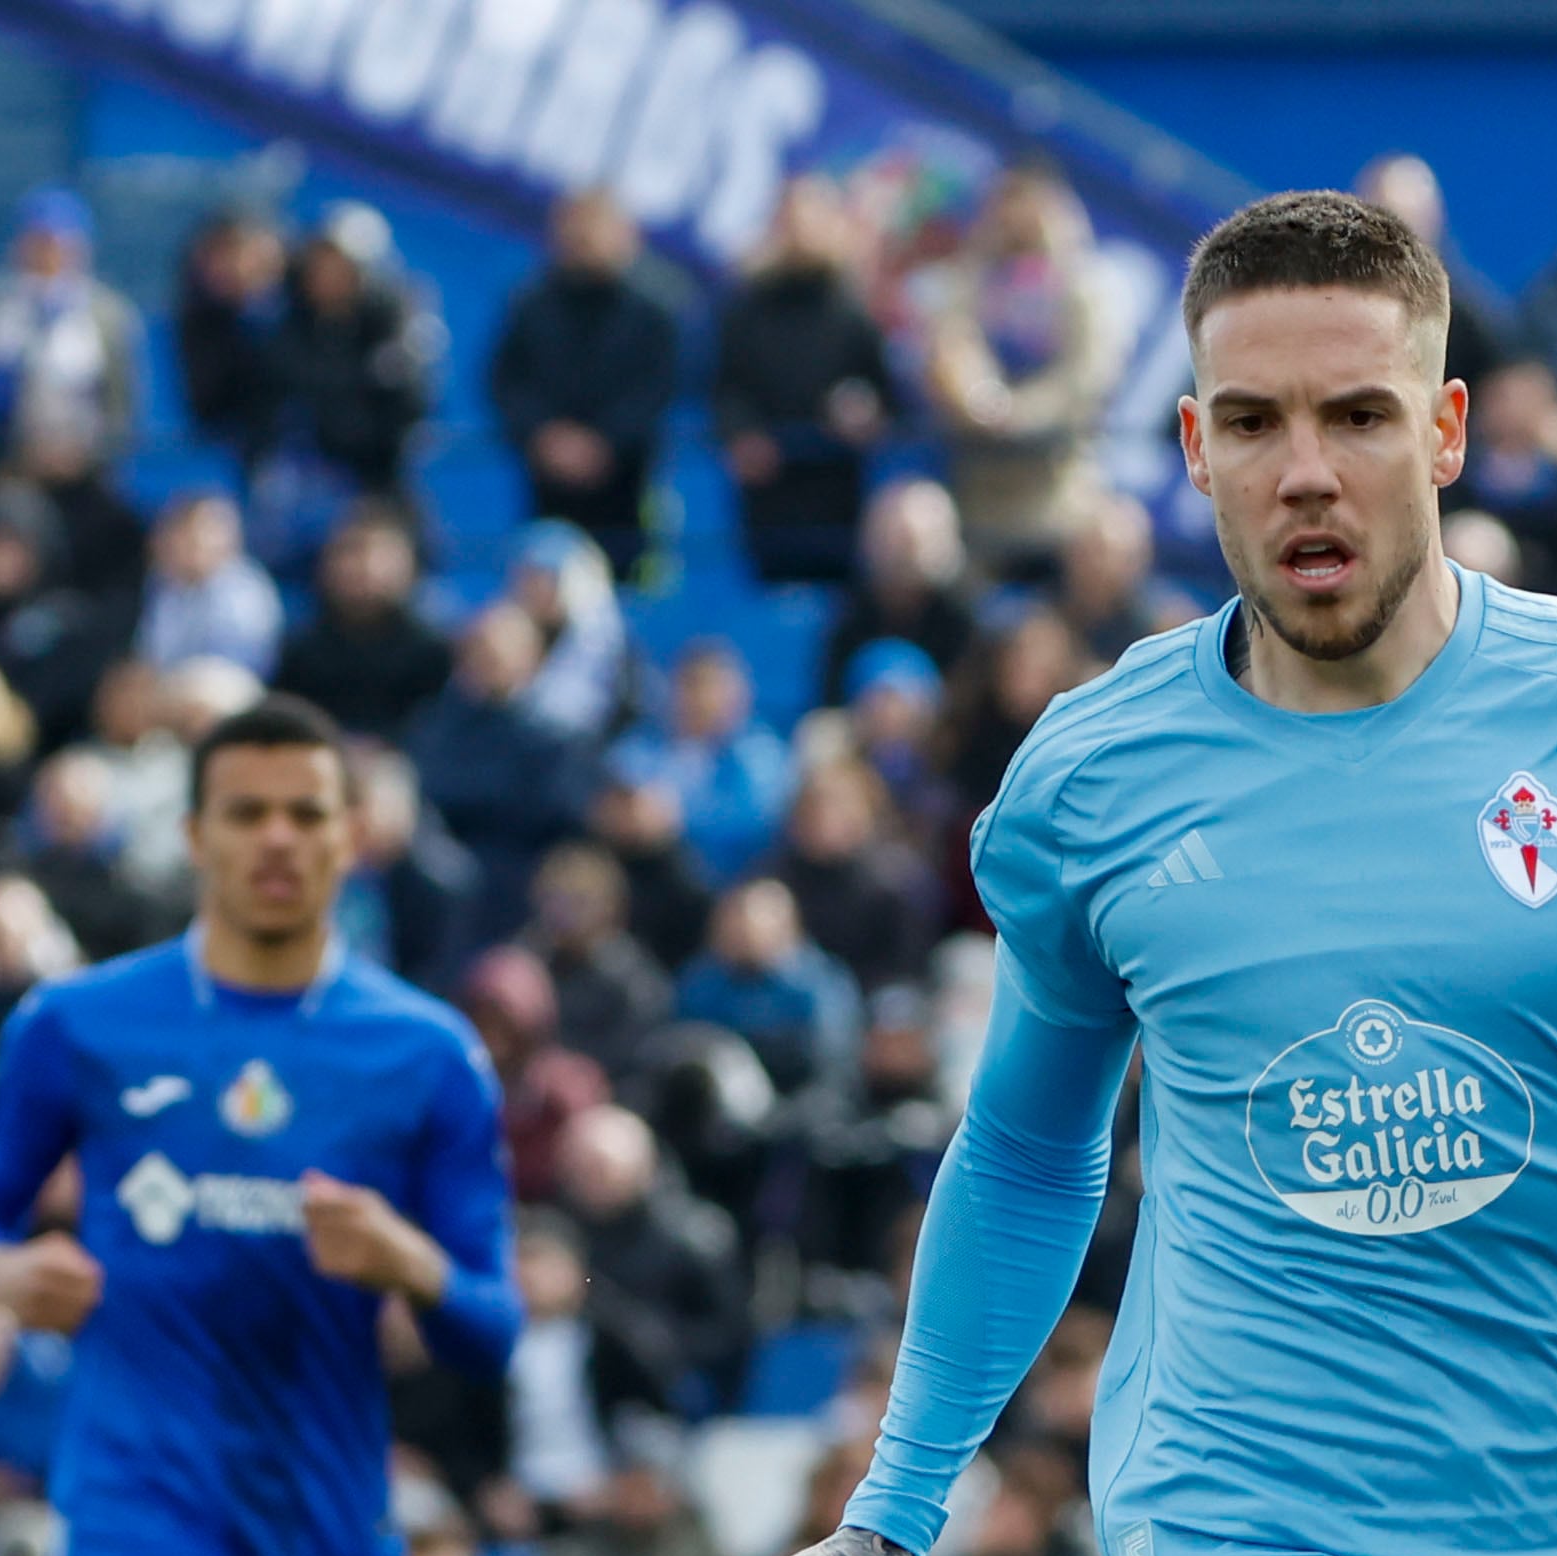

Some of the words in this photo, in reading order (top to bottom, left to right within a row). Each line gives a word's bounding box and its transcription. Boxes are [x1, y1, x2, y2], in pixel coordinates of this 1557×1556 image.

[1289, 1068, 1486, 1129] Estrella
[1303, 1122, 1485, 1183] Galicia
[1367, 1178, 1424, 1224] 0,0
